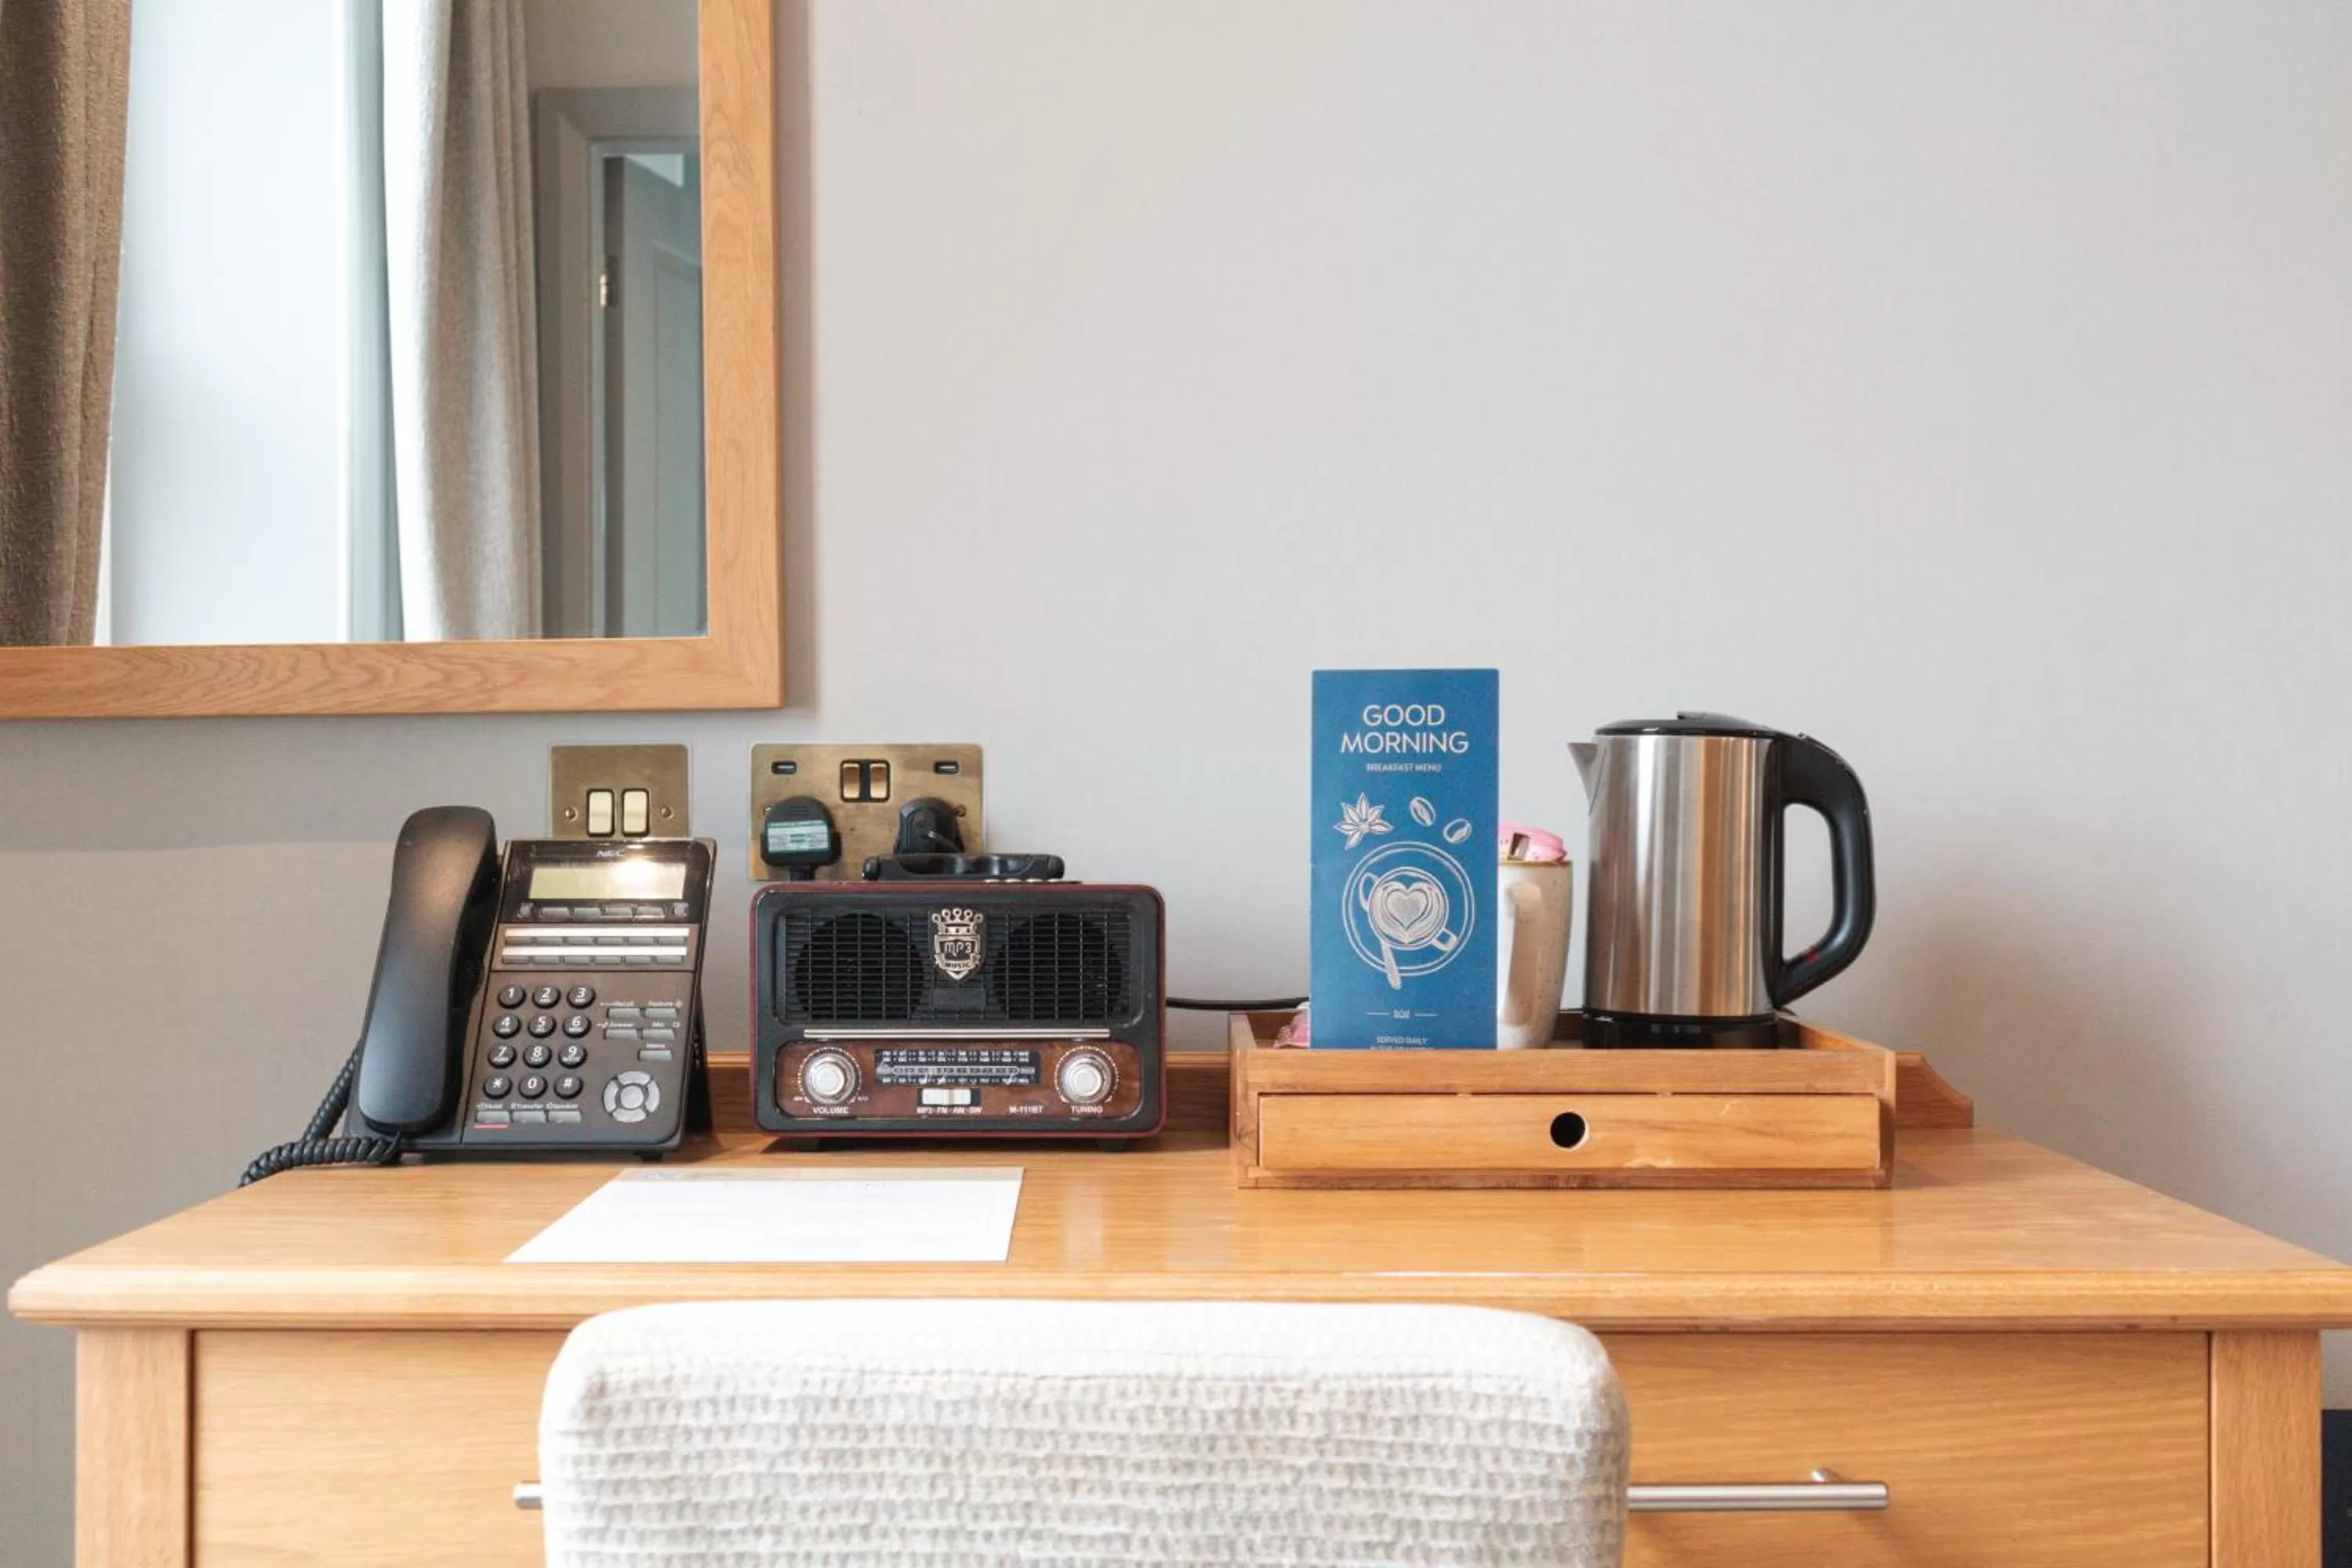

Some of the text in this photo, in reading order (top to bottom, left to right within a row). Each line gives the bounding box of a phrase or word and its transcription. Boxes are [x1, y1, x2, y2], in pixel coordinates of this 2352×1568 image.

[1363, 703, 1446, 727] GOOD
[1340, 731, 1469, 754] MORNING
[1367, 763, 1443, 772] BREAKFAST MENU
[944, 942, 972, 956] MP3
[508, 987, 515, 998] 1
[541, 987, 551, 998] 2
[576, 987, 586, 998] 3
[501, 1016, 510, 1027] 4
[538, 1016, 546, 1025] 5
[572, 1016, 581, 1026] 6
[498, 1045, 507, 1057] 7
[532, 1045, 543, 1057] 8
[568, 1045, 578, 1056] 9
[528, 1078, 537, 1089] 0
[1070, 1105, 1103, 1114] TUNING
